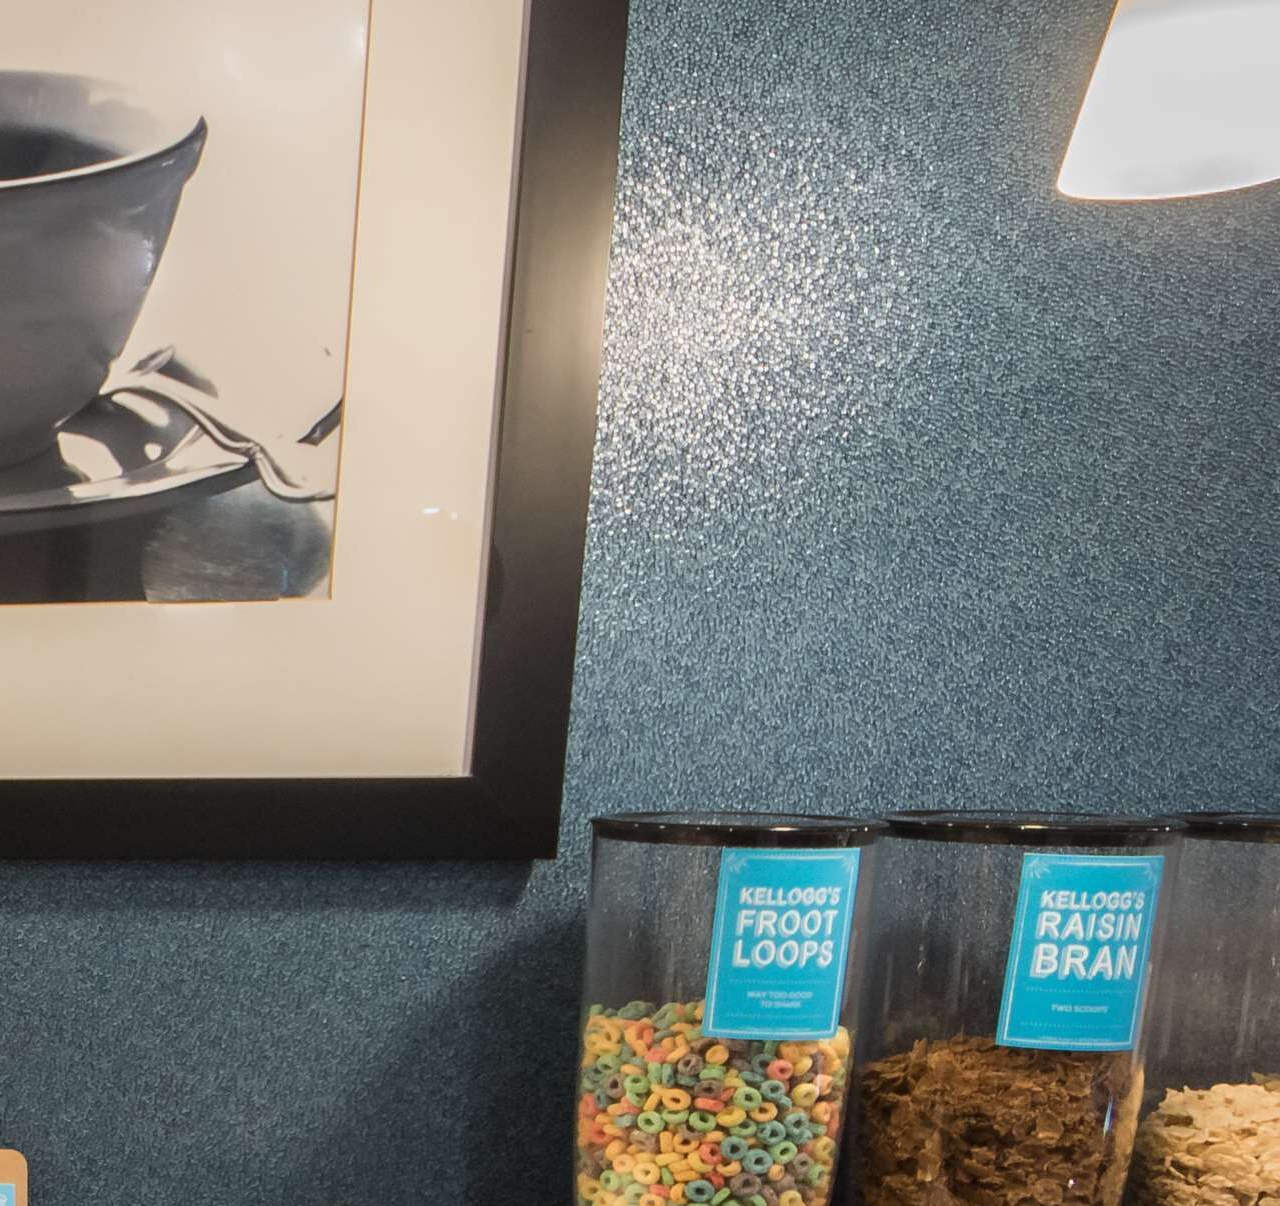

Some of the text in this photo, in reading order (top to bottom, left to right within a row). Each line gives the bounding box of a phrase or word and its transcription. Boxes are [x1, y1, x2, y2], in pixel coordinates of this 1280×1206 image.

[739, 887, 841, 906] KELLOGG'S
[1040, 889, 1145, 911] KELLOGG'S
[736, 909, 839, 938] FROOT
[1035, 911, 1142, 942] RAISIN
[732, 938, 834, 969] LOOPS
[1029, 943, 1138, 981] BRAN
